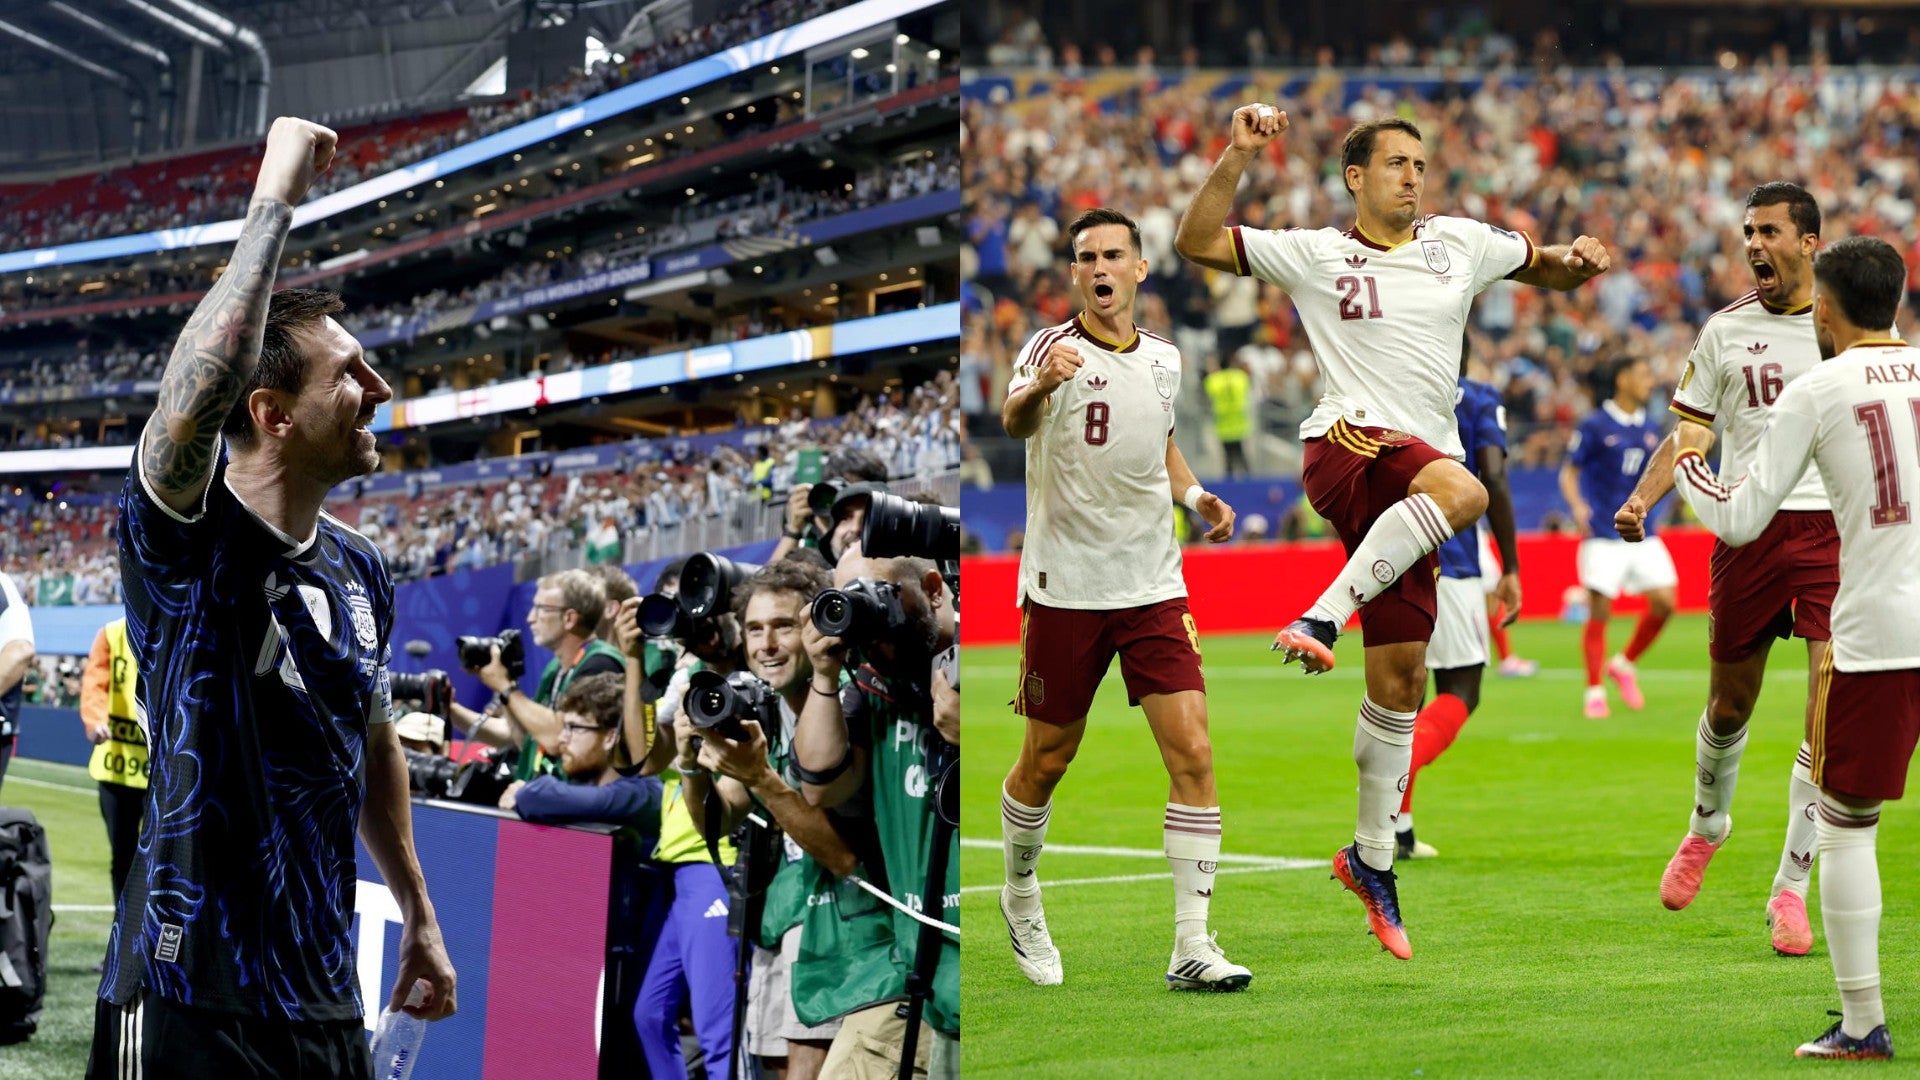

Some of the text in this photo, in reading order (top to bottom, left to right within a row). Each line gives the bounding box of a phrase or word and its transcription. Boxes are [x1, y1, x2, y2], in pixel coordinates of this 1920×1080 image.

[1335, 275, 1384, 320] 21
[535, 361, 633, 406] 1 2
[1742, 363, 1784, 408] 16
[1865, 363, 1920, 384] ALEX
[1085, 402, 1110, 446] 8
[1182, 612, 1202, 655] 8
